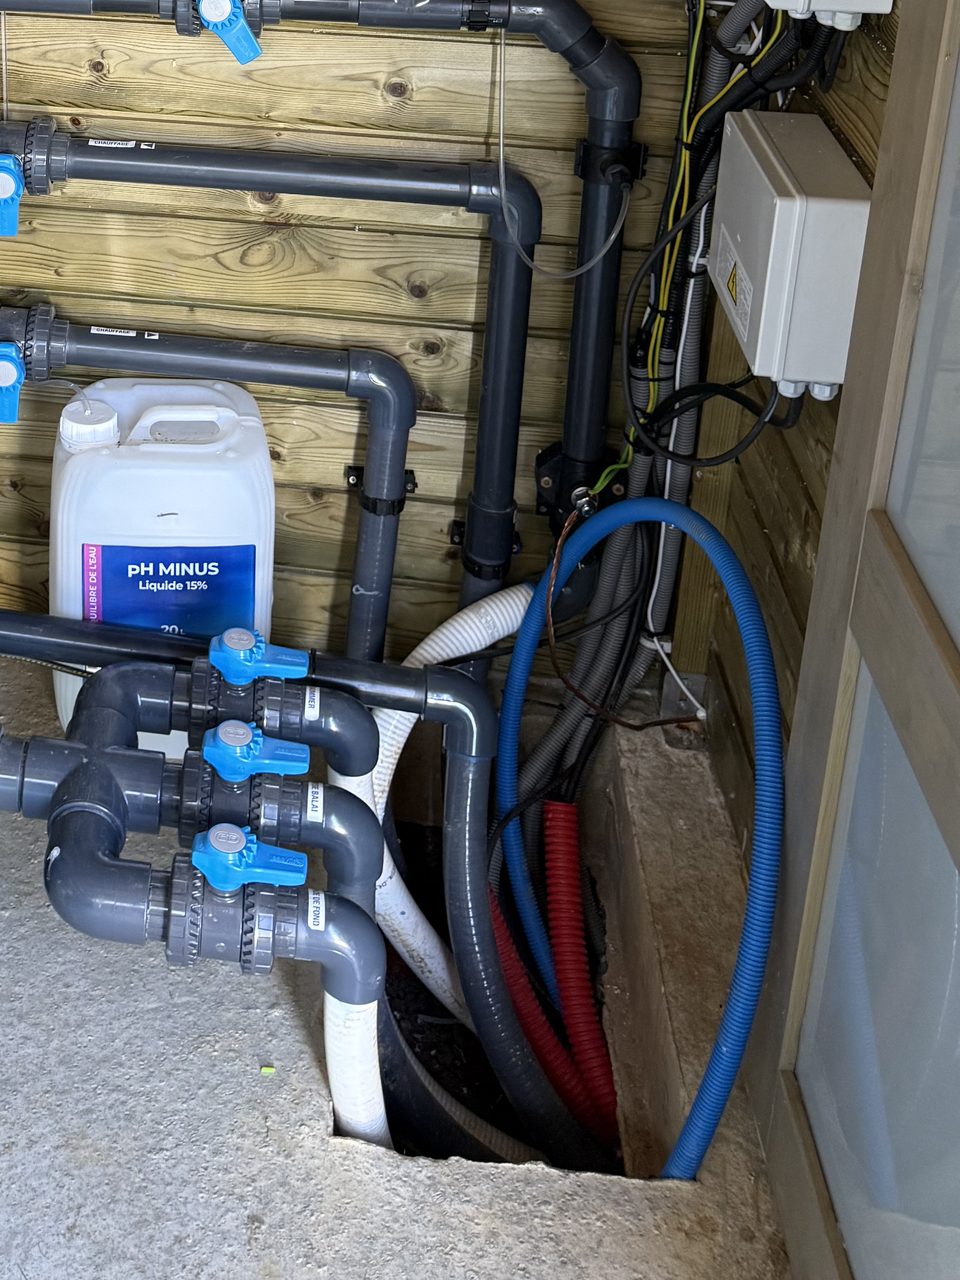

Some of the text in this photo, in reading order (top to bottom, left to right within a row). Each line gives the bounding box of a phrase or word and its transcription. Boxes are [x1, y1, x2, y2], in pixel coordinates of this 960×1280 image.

[127, 562, 219, 578] pH MINUS
[89, 547, 97, 624] UILIBRE DE L'EAU
[139, 580, 208, 592] Liquide 15%
[311, 787, 319, 813] BALAI
[312, 906, 320, 927] FOND
